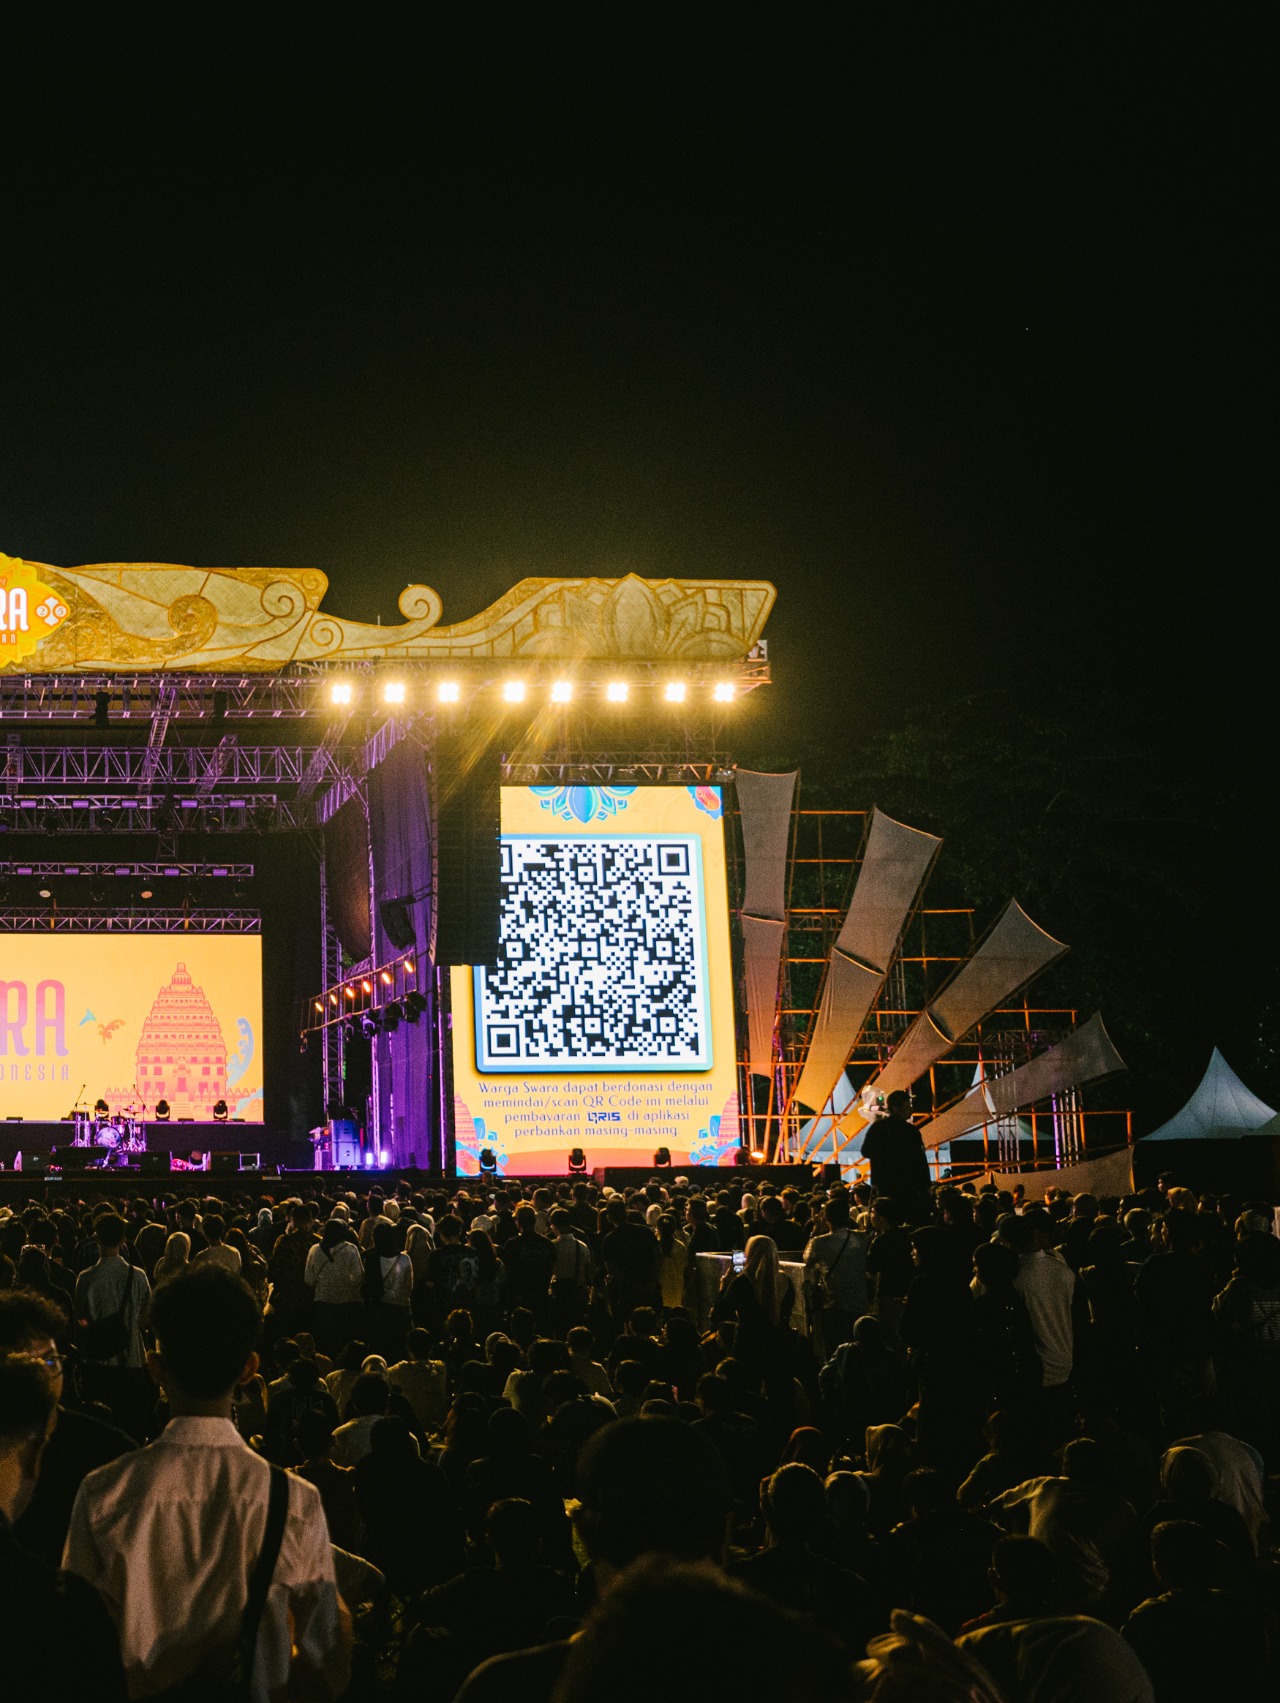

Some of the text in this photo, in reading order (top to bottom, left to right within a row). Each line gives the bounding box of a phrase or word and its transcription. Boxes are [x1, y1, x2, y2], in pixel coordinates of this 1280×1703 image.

[479, 1081, 713, 1095] Warga Swara dapat berdonasi dengan
[484, 1095, 709, 1108] memindai/scan QR Code ini melalui
[504, 1110, 580, 1123] pembayaran
[628, 1110, 639, 1121] di
[643, 1109, 690, 1122] aplikasi
[514, 1125, 681, 1138] perbankan masing-masing.
